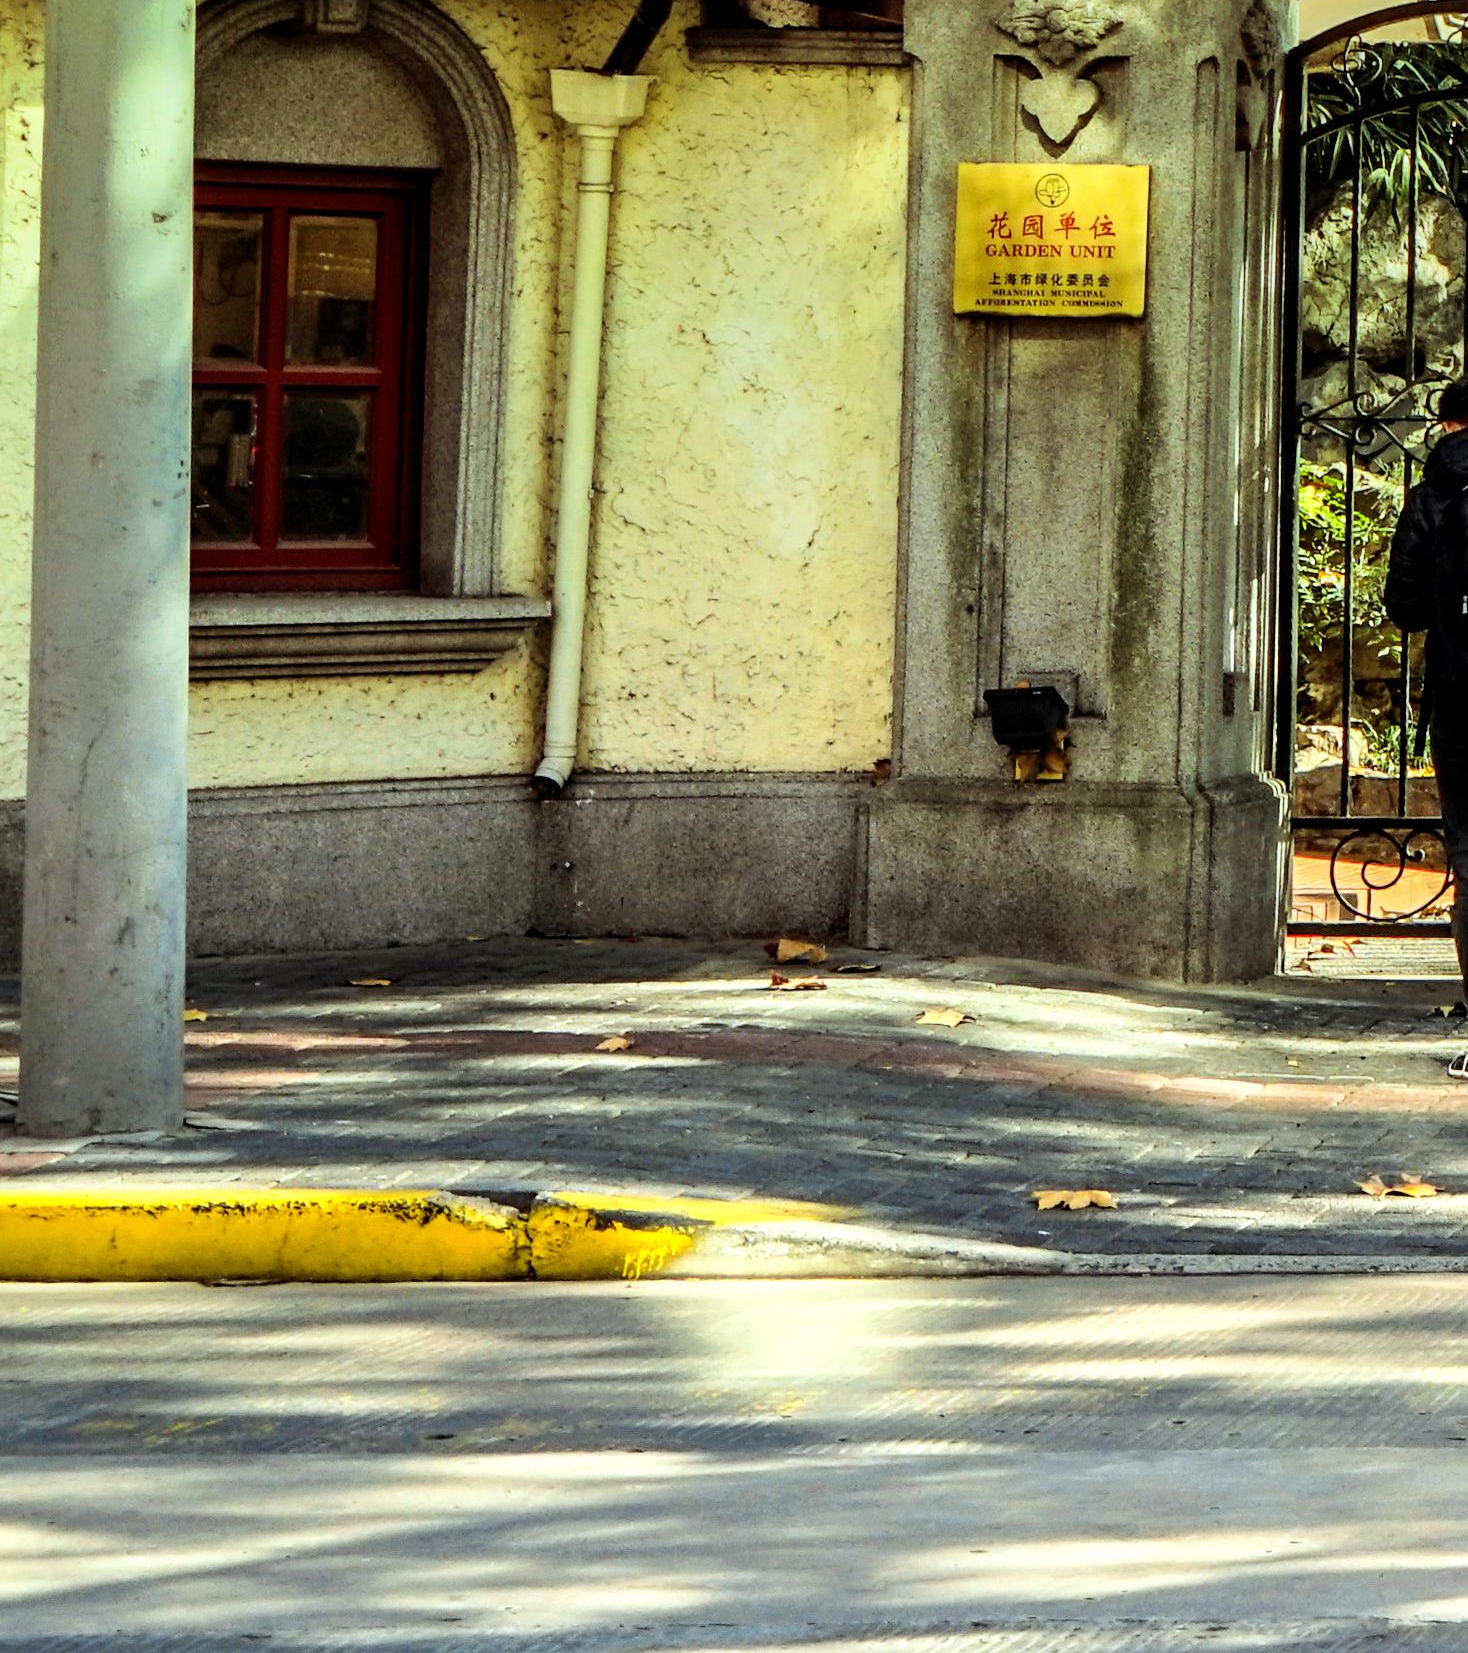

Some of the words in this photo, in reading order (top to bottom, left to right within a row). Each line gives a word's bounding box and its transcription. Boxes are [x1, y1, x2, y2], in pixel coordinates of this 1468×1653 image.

[986, 211, 1117, 240] 花园单位
[985, 243, 1062, 258] GARDEN
[1070, 245, 1116, 259] UNIT
[988, 272, 1110, 287] 上海市绿化委员会
[992, 289, 1046, 297] SHANGHAI
[1050, 289, 1106, 298] MUNICIPAL
